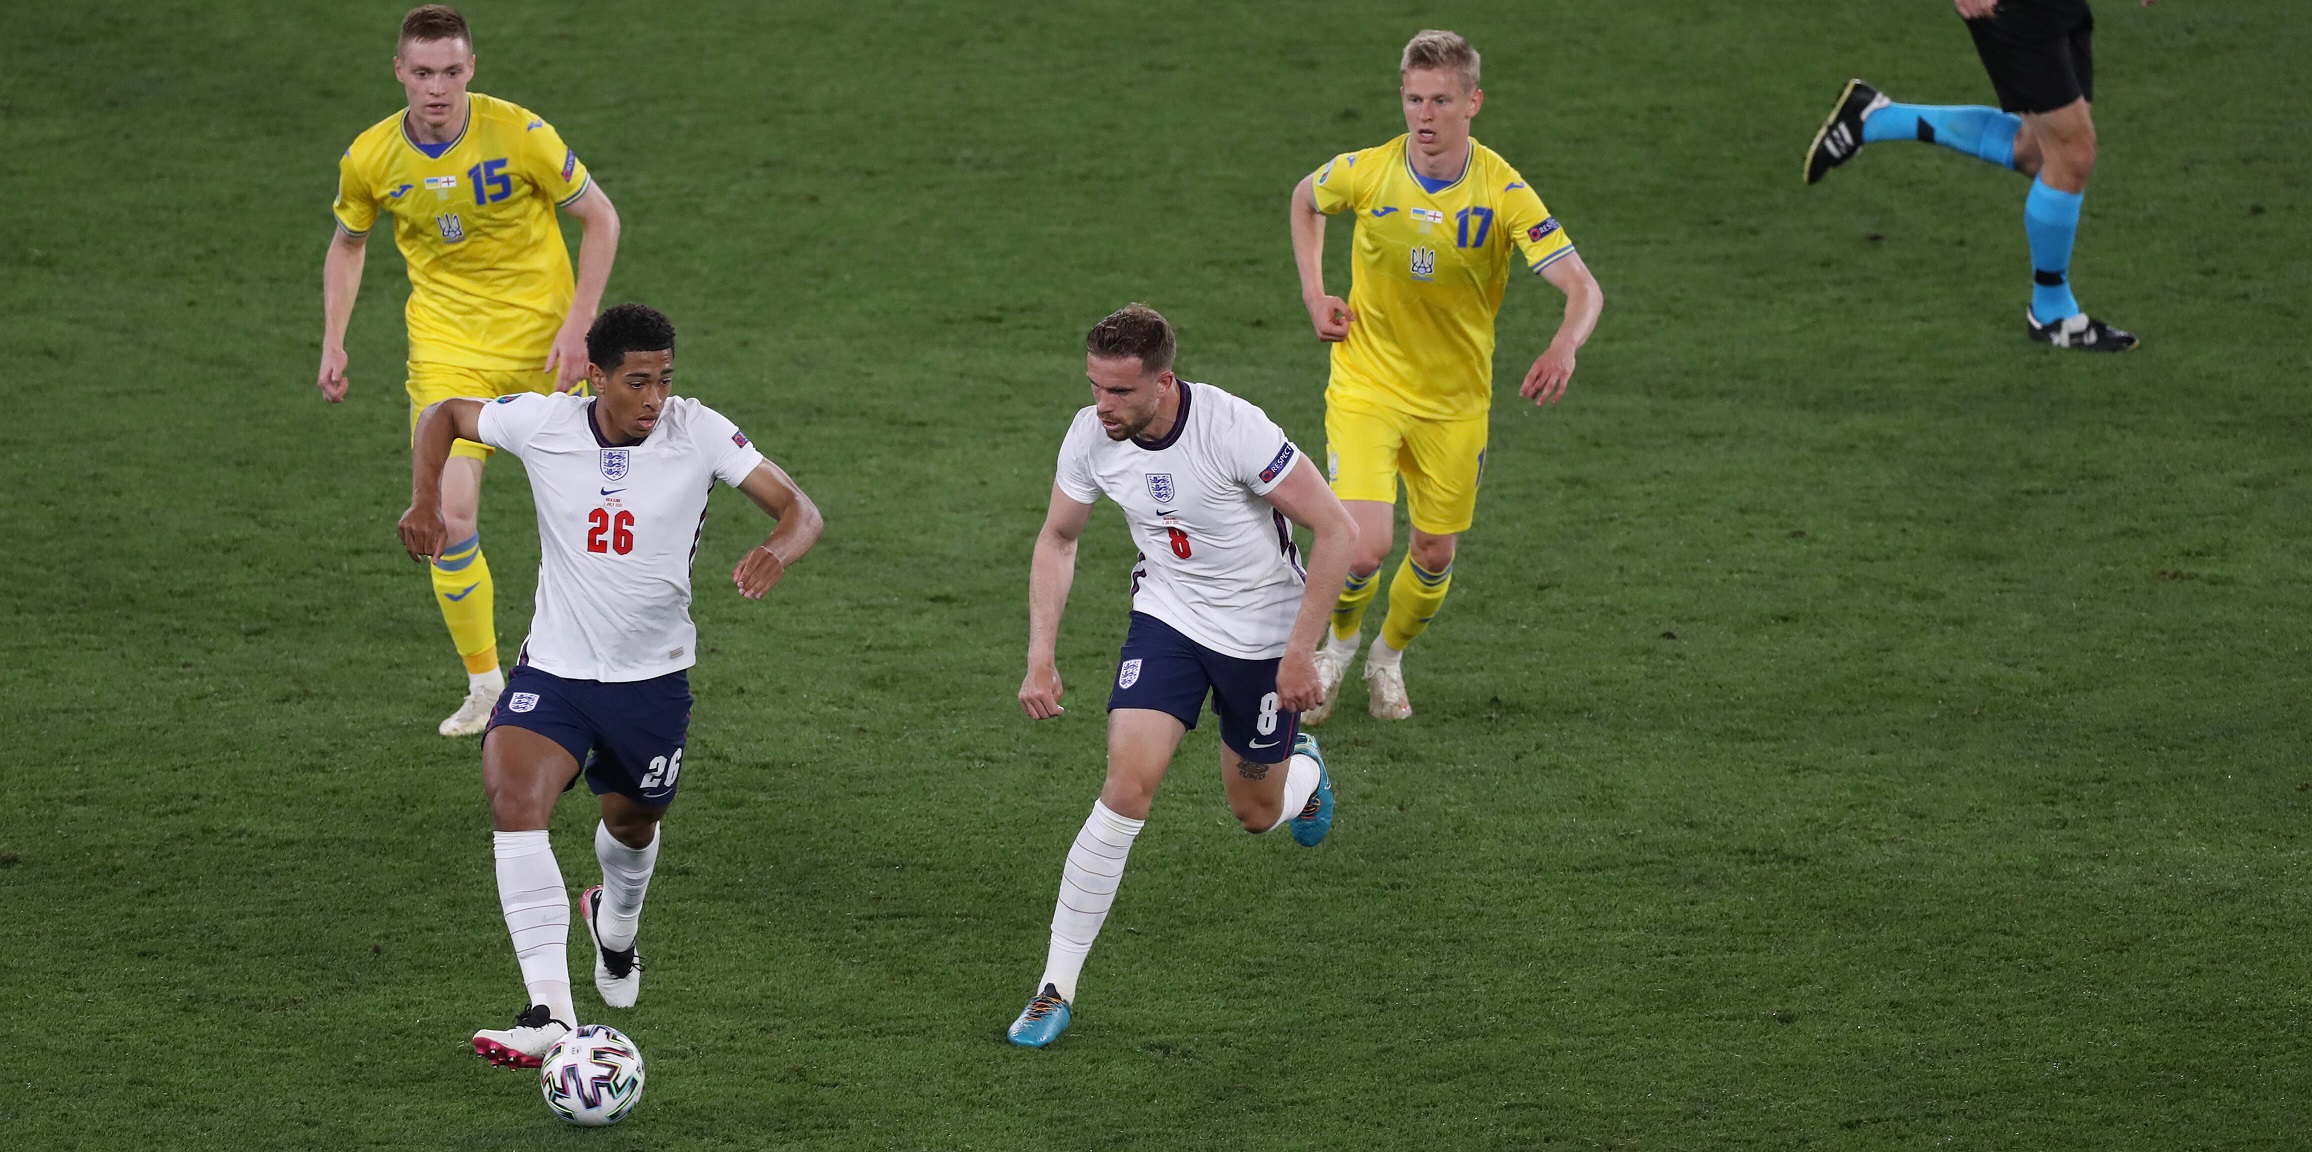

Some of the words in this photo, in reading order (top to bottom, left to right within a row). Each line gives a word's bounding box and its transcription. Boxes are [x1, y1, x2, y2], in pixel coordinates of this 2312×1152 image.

[467, 158, 512, 206] 15
[1455, 206, 1494, 248] 17
[1270, 445, 1292, 473] RESPECT
[587, 507, 635, 556] 26
[1167, 526, 1193, 559] 8
[1256, 691, 1280, 736] 8
[639, 747, 683, 789] 26
